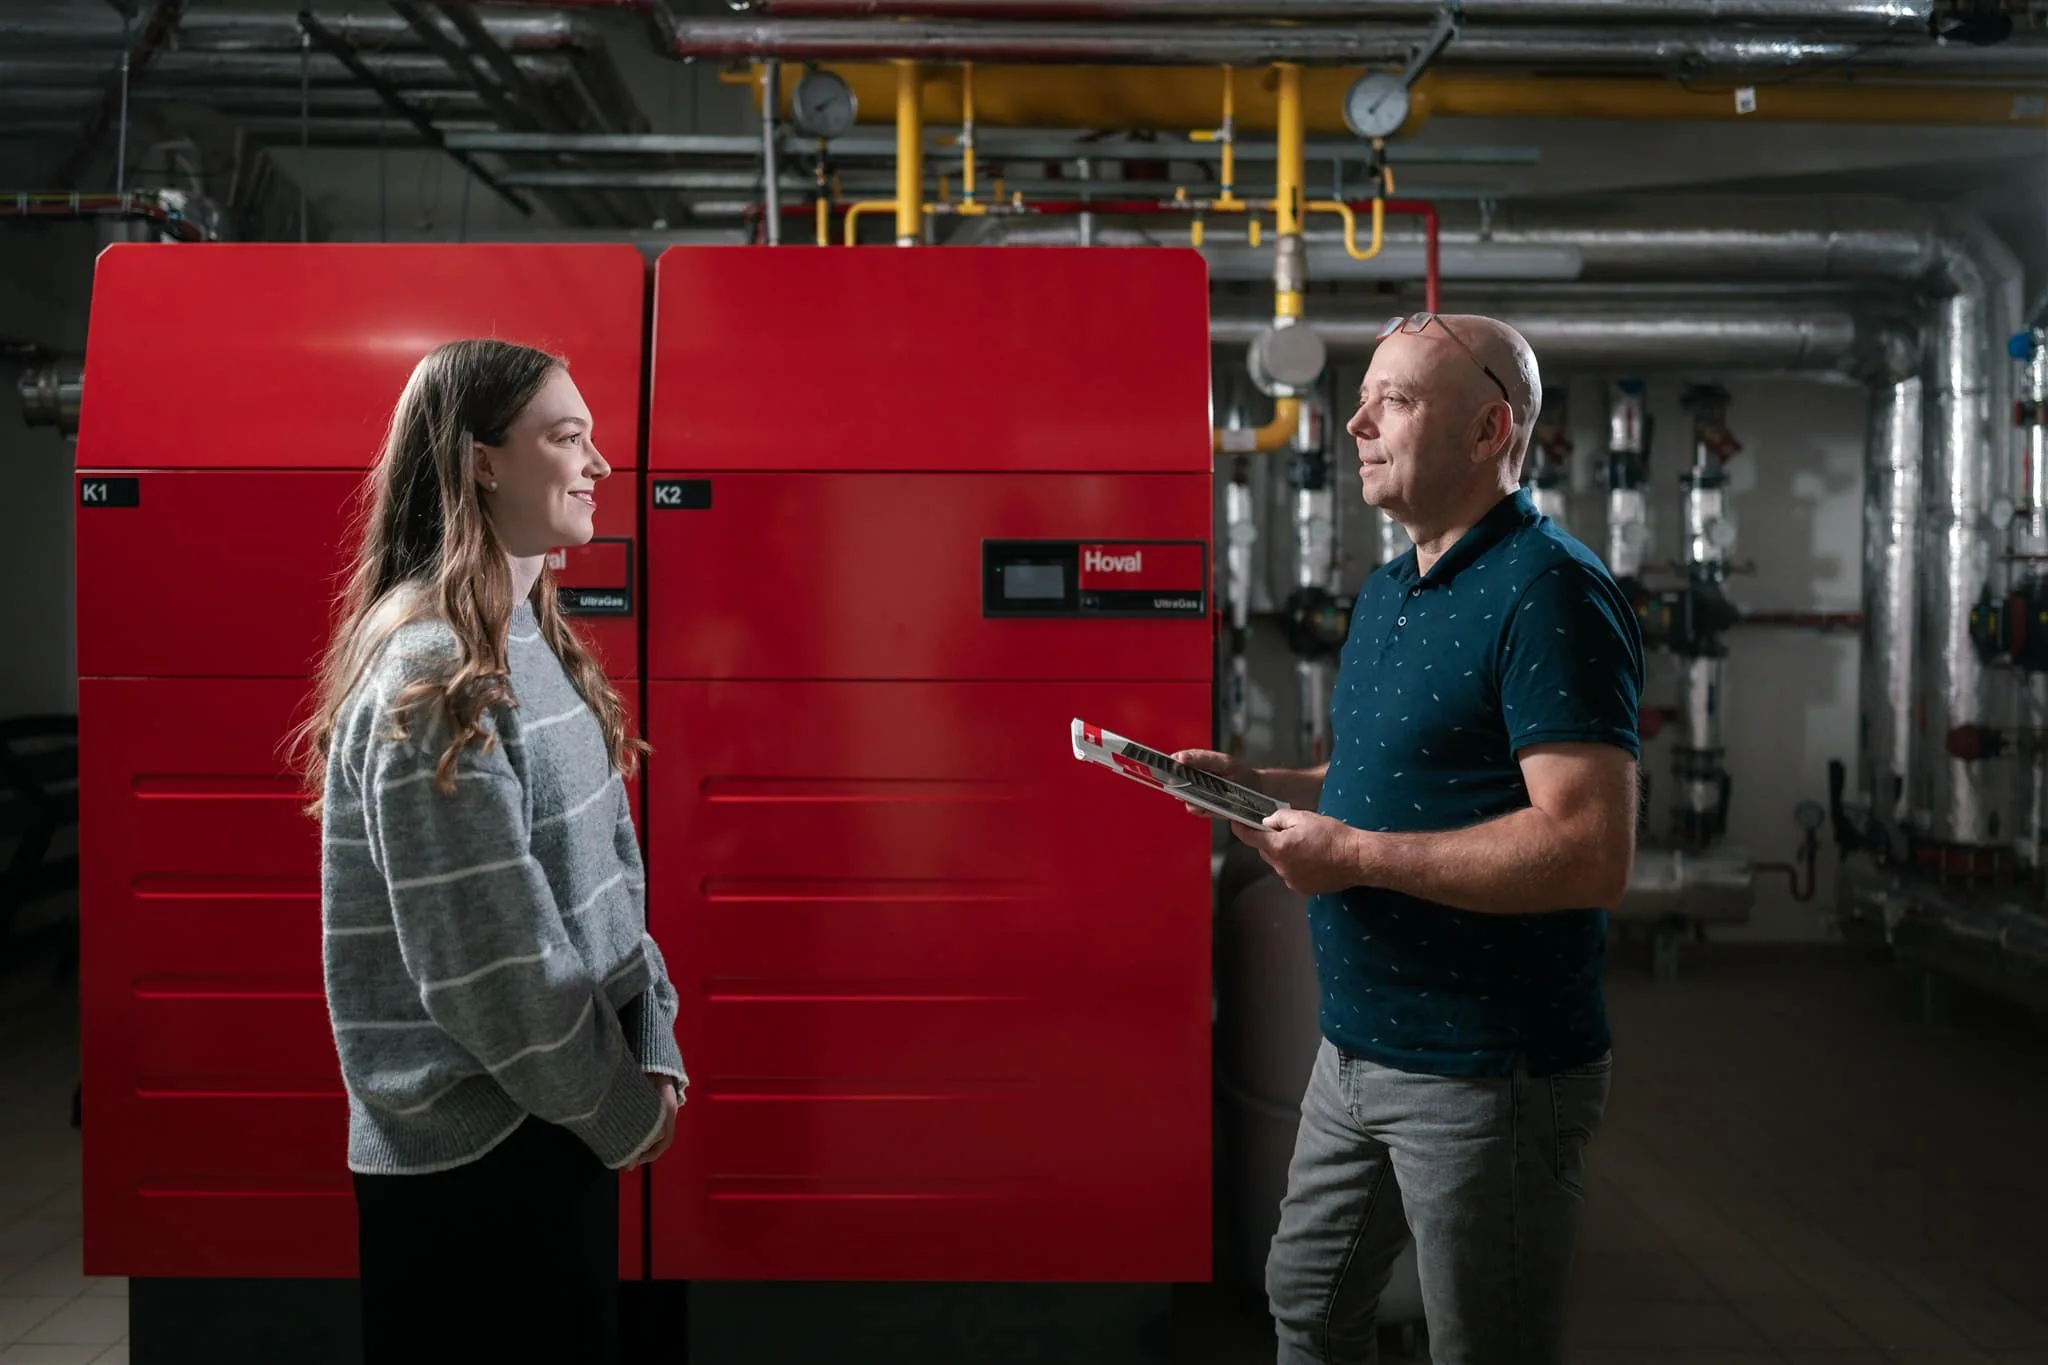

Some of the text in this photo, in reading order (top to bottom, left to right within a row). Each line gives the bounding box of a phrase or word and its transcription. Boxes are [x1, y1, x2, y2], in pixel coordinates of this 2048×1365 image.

[83, 483, 107, 502] K1
[655, 486, 682, 504] K2
[1084, 550, 1142, 573] Hoval
[580, 596, 624, 607] UltraGas
[1154, 598, 1198, 609] UltraGas
